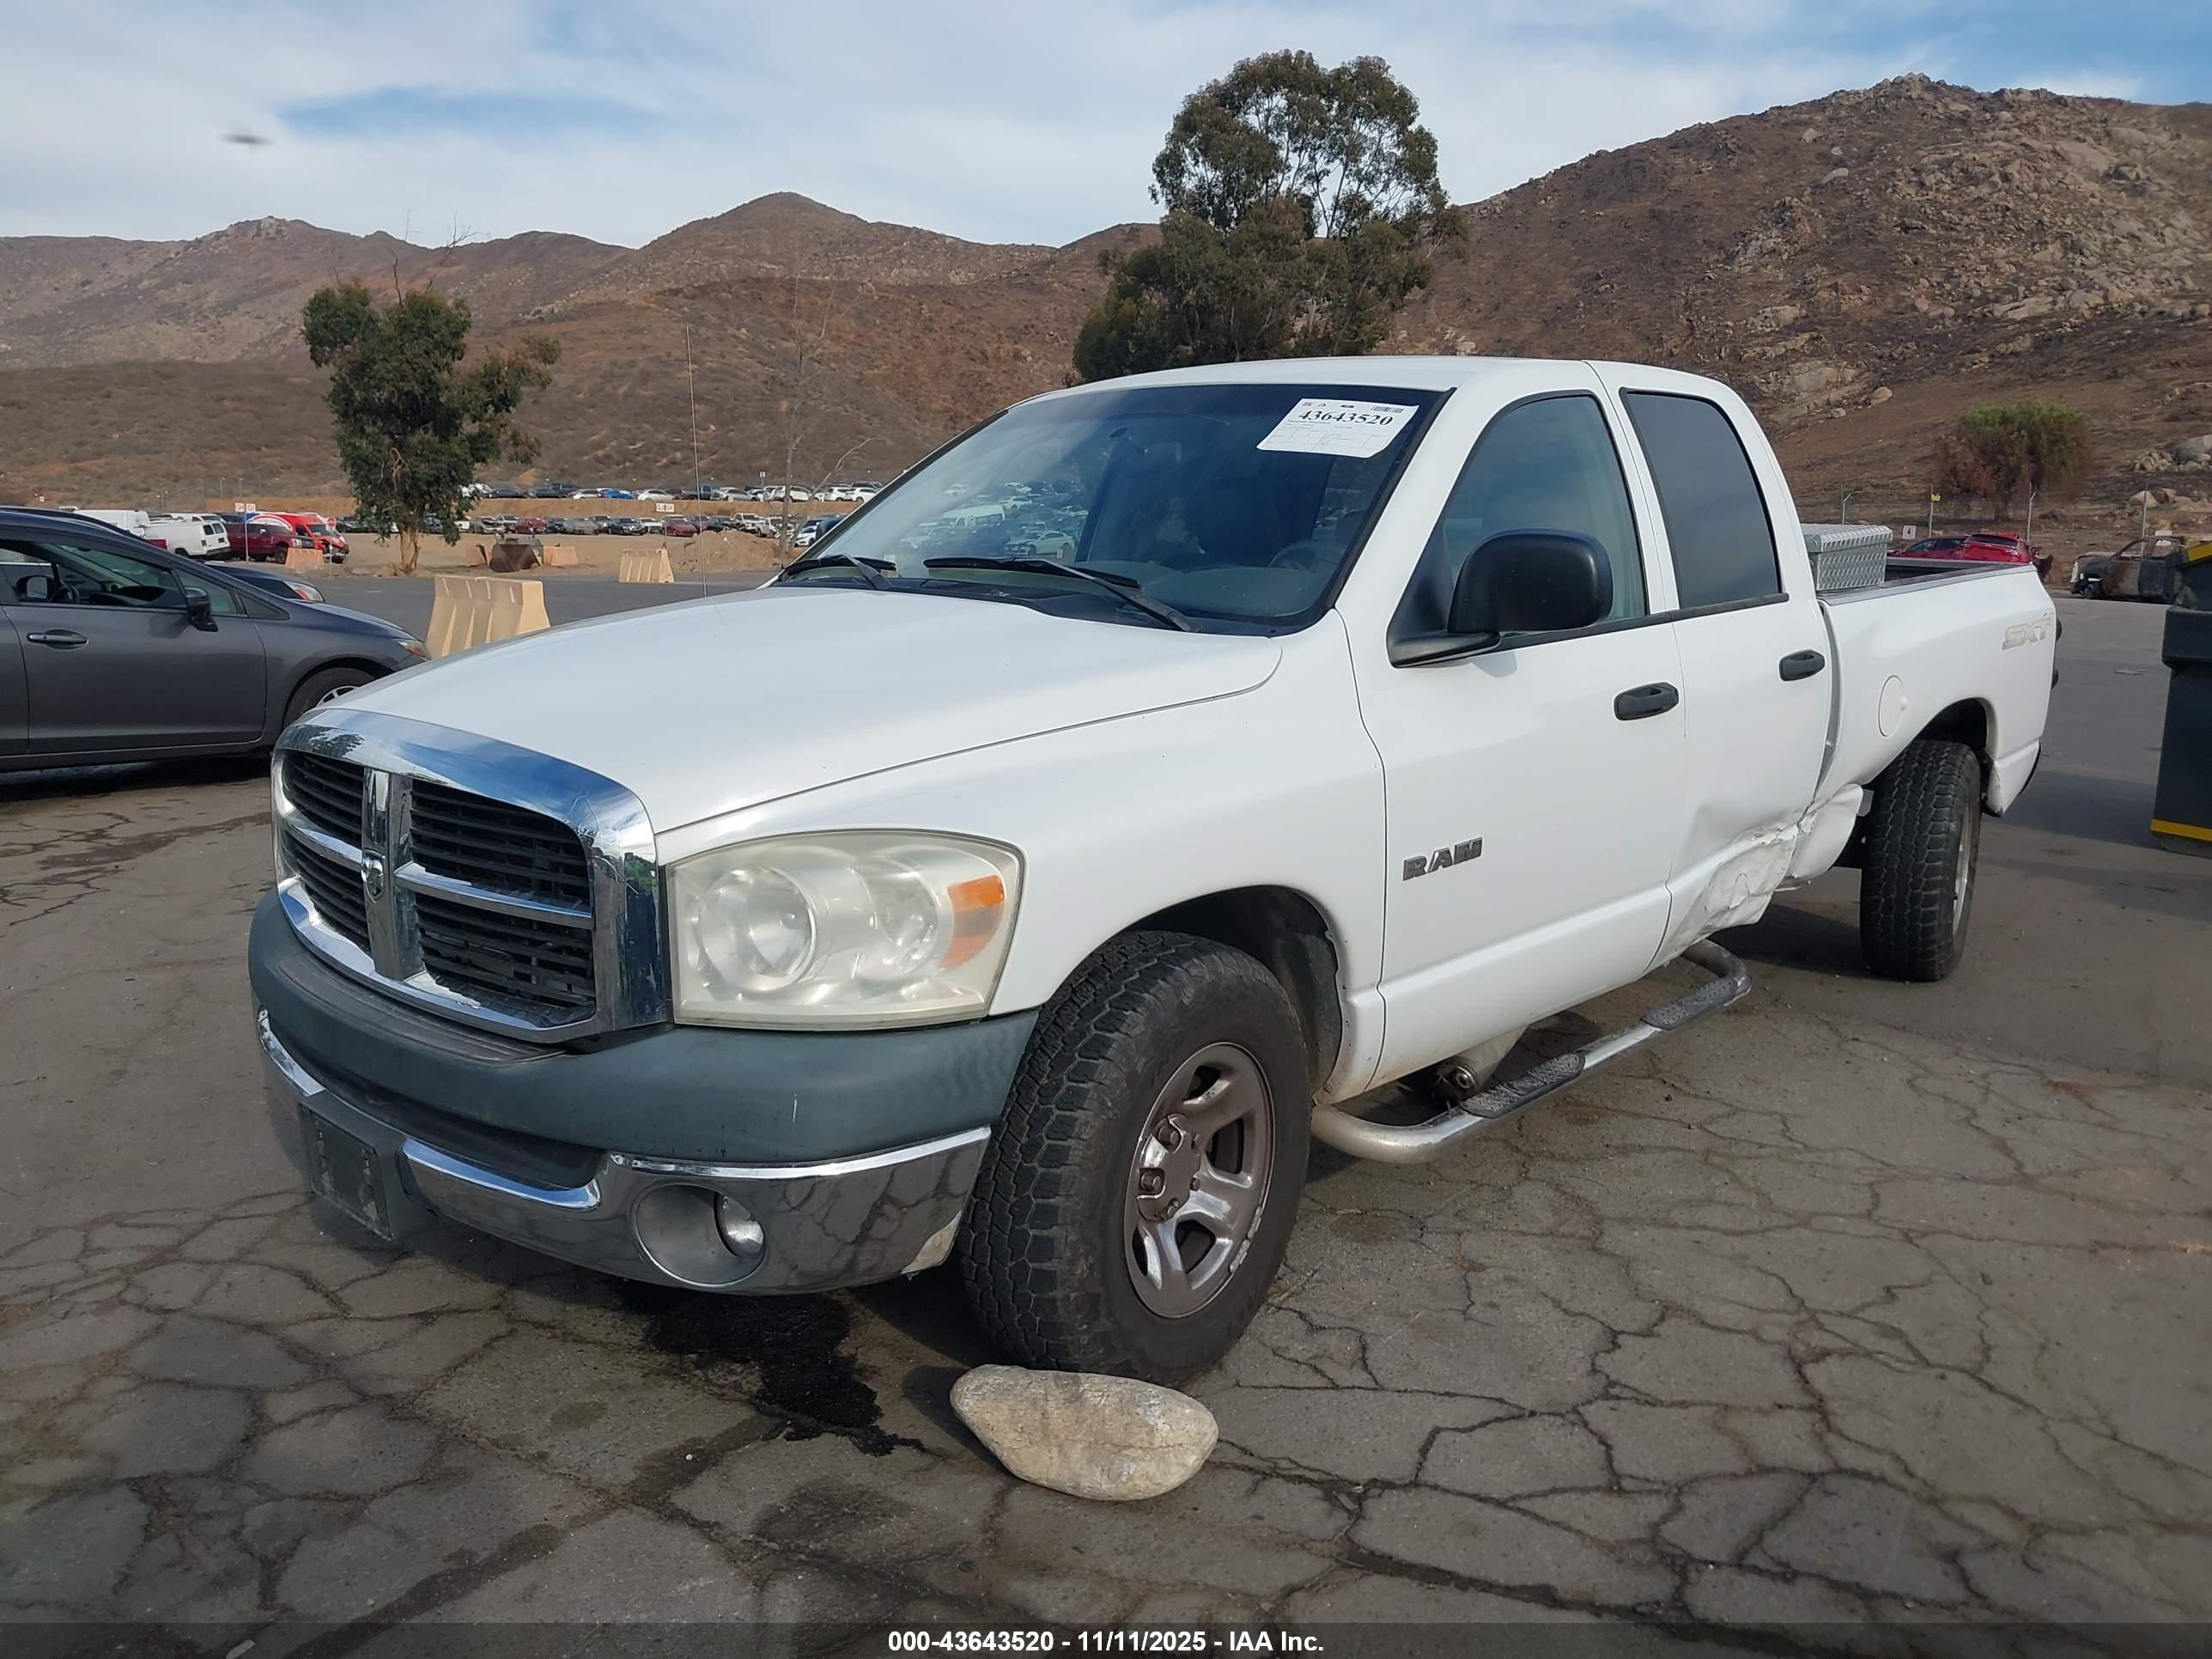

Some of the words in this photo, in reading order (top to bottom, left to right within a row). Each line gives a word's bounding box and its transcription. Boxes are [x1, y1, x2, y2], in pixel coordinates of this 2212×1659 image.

[1297, 410, 1394, 426] 43643520
[2002, 617, 2051, 650] SXT
[1402, 836, 1483, 881] RAM
